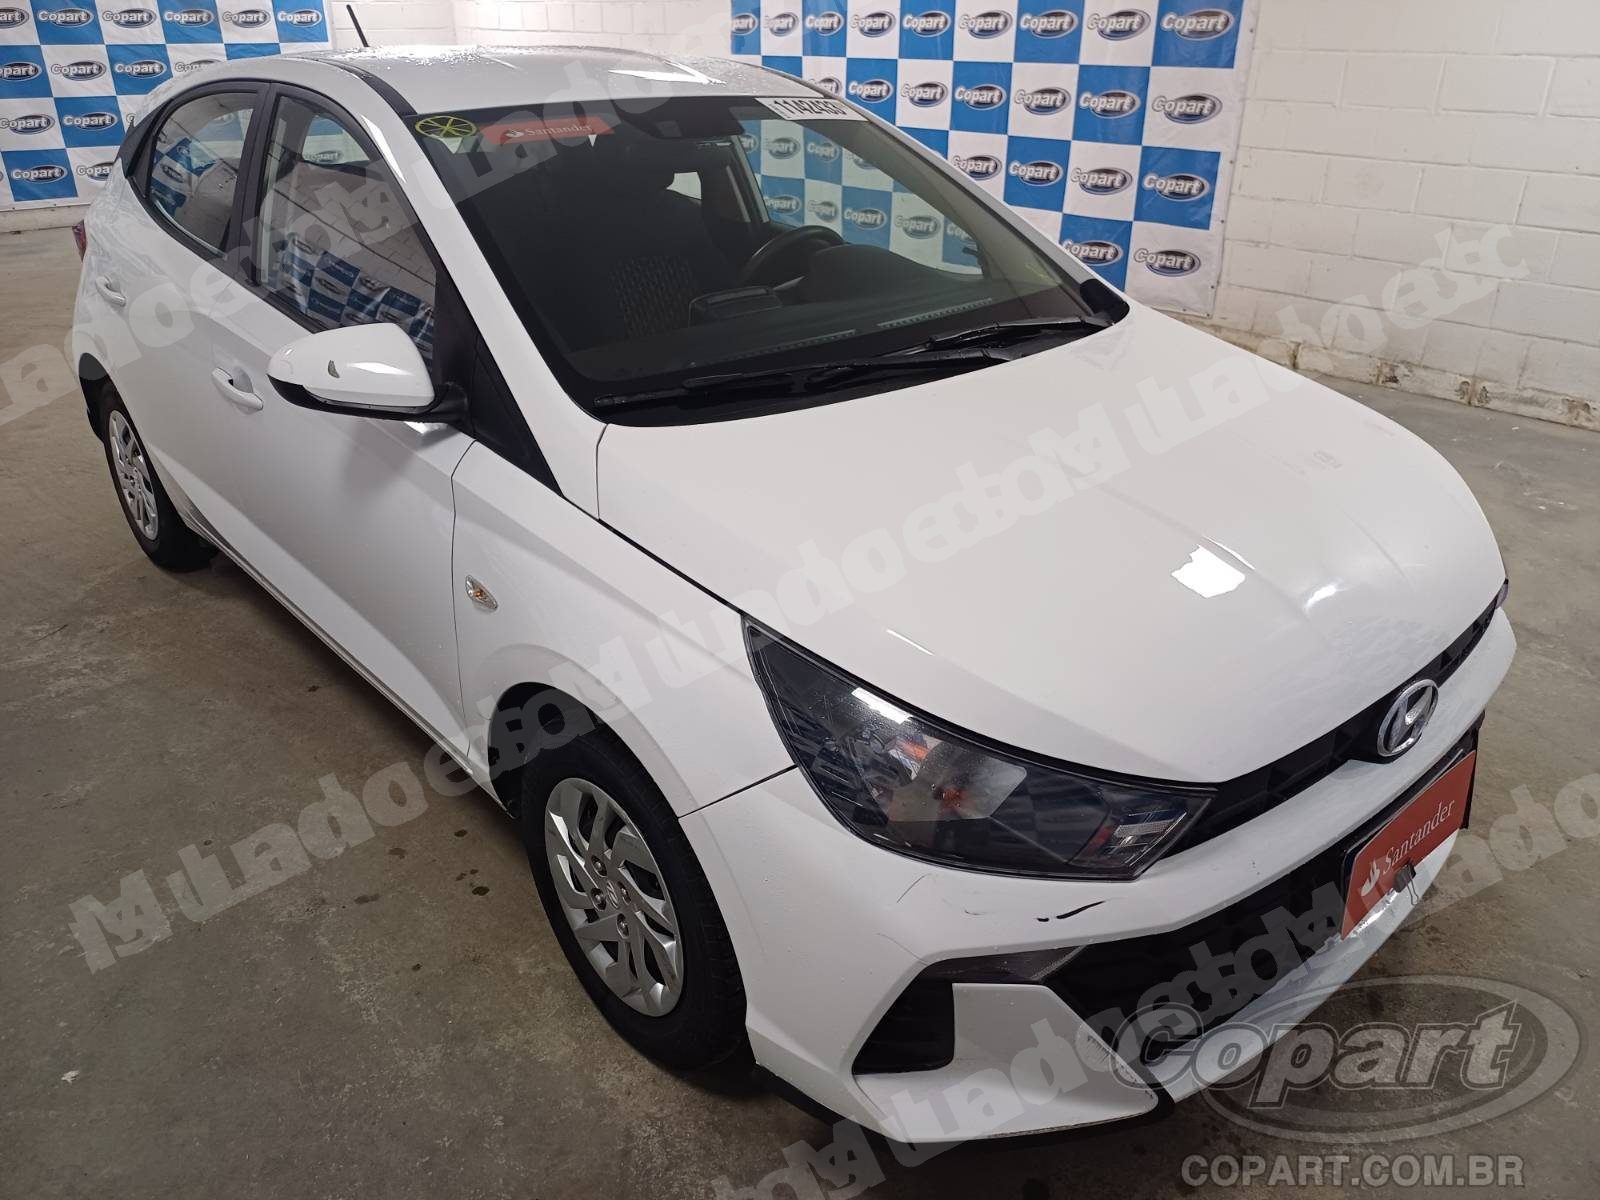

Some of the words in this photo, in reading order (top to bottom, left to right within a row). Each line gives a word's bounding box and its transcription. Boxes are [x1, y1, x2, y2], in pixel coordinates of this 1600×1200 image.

[38, 10, 86, 24] Copart
[102, 11, 149, 24] Copart
[164, 11, 209, 24] Copart
[222, 11, 265, 24] Copart
[278, 11, 318, 24] Copart
[806, 14, 839, 31] Copart
[850, 14, 890, 31] Copart
[902, 13, 946, 32] Copart
[960, 13, 1005, 32] Copart
[1020, 12, 1070, 32] Copart
[1087, 12, 1141, 33] Copart
[1161, 11, 1226, 34] Copart
[51, 63, 98, 77] Copart
[115, 63, 160, 76] Copart
[848, 80, 888, 98] Copart
[901, 83, 943, 102] Copart
[955, 85, 1001, 104] Copart
[1014, 89, 1065, 110] Copart
[1079, 91, 1132, 112] Copart
[1152, 96, 1213, 119] Copart
[63, 114, 112, 127] Copart
[524, 123, 593, 137] Santander
[11, 167, 61, 181] Copart
[76, 164, 110, 177] Copa
[1008, 160, 1057, 182] Copart
[1071, 167, 1123, 190] Copart
[1143, 174, 1201, 197] Copart
[843, 207, 882, 225] Copart
[1134, 248, 1194, 271] Copart
[1382, 799, 1455, 876] Santander
